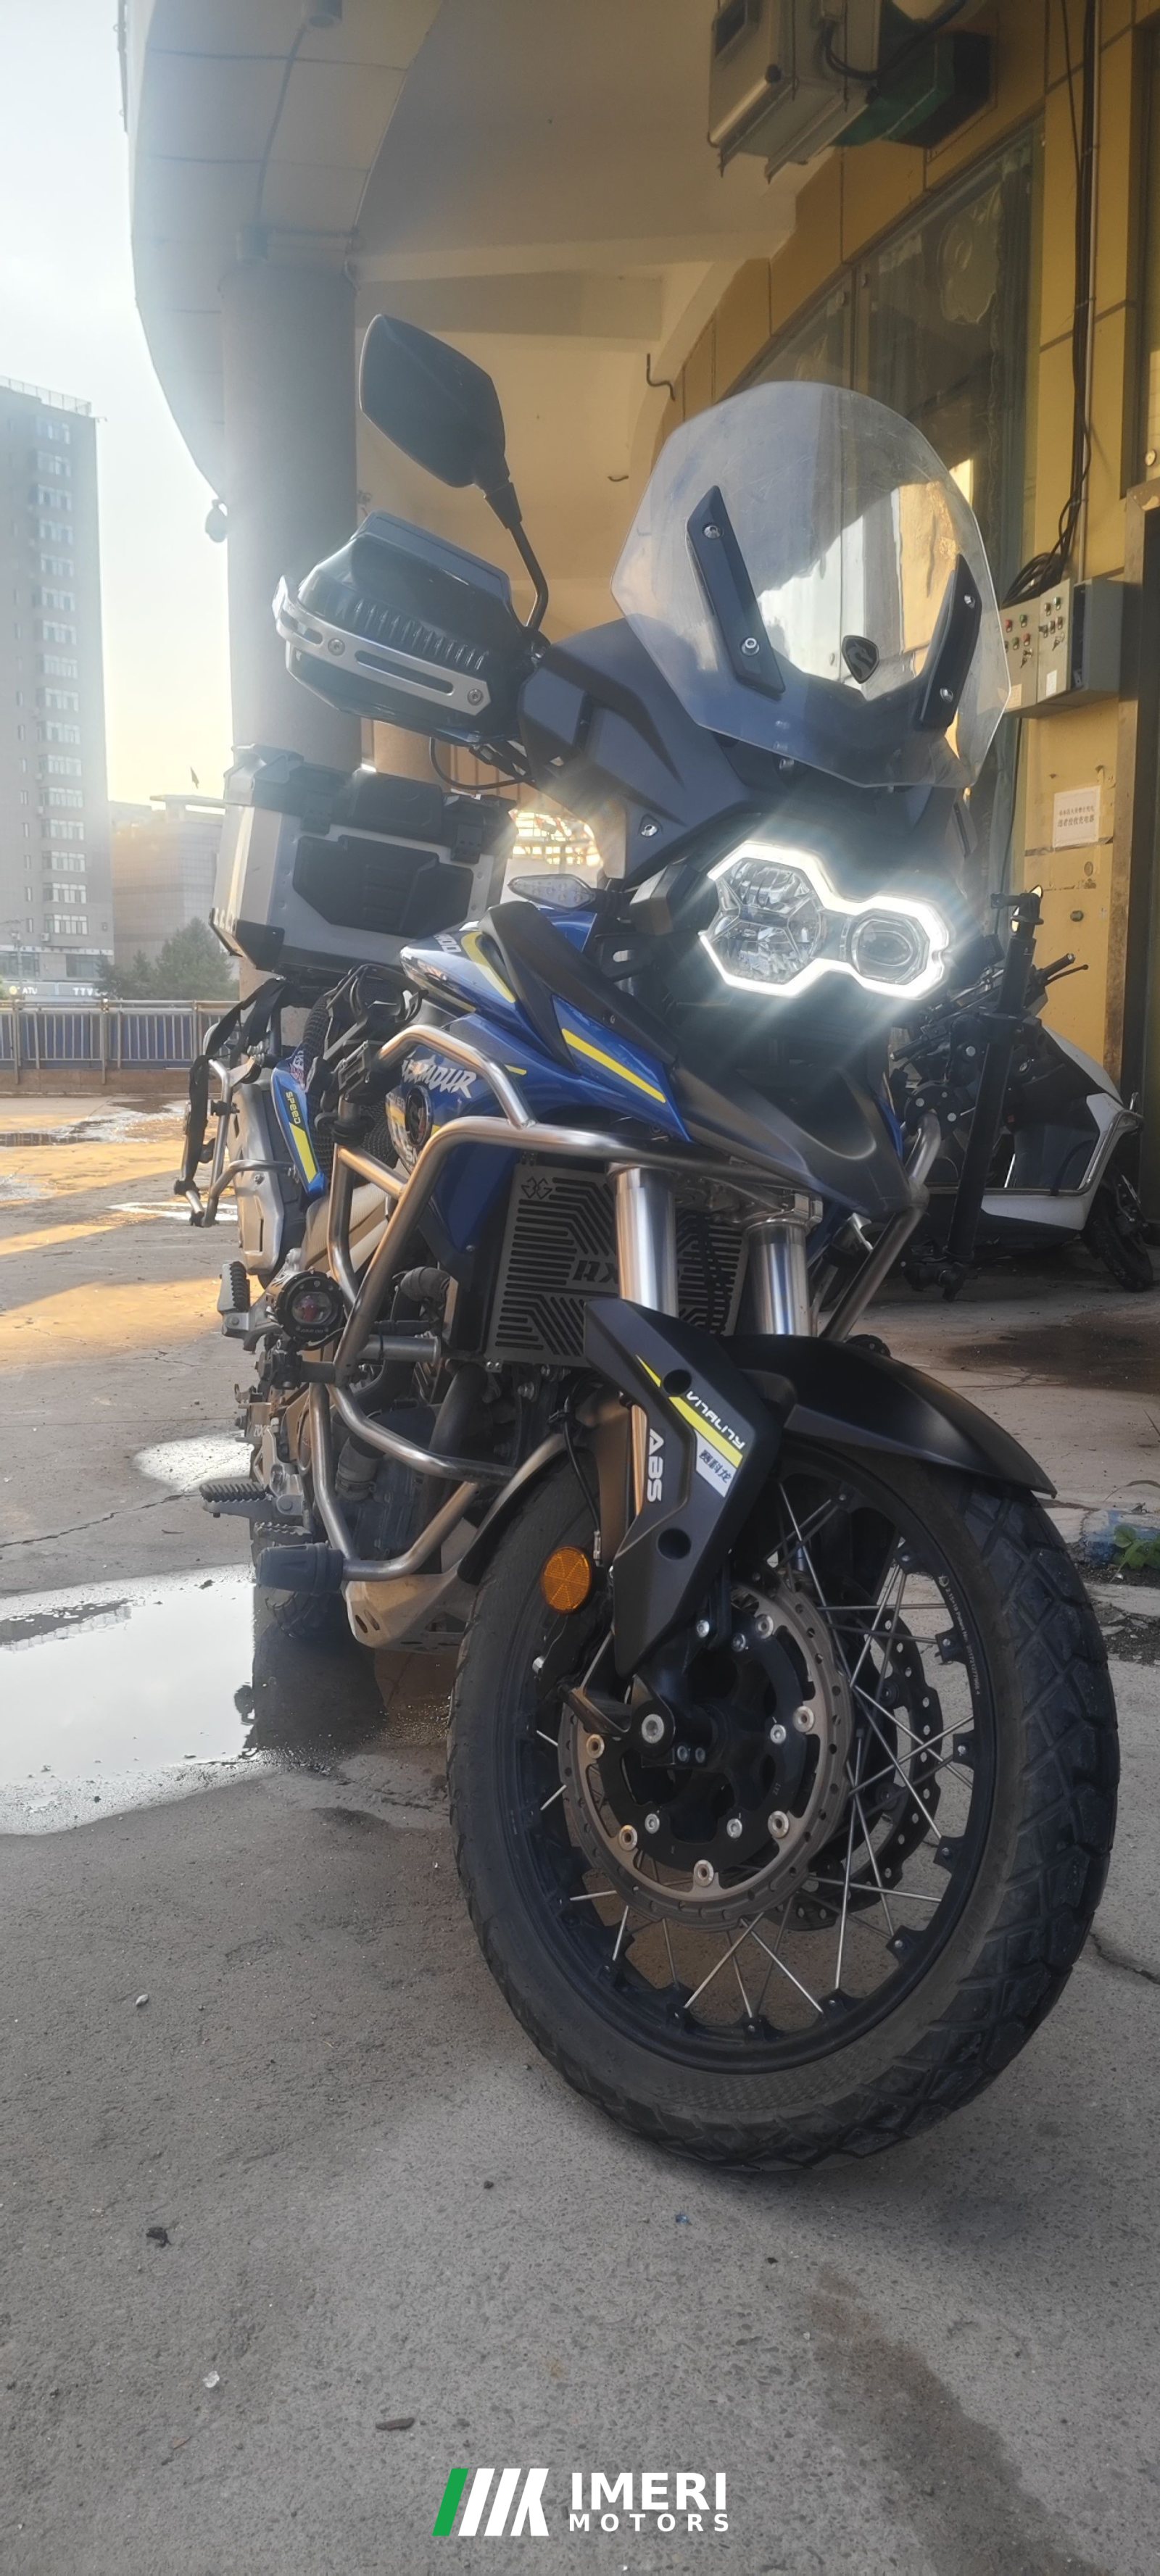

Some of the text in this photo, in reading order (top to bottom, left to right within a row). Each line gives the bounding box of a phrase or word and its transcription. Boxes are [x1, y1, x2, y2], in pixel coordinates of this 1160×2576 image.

[647, 1428, 665, 1503] ABS
[698, 1449, 732, 1484] 赛科龙
